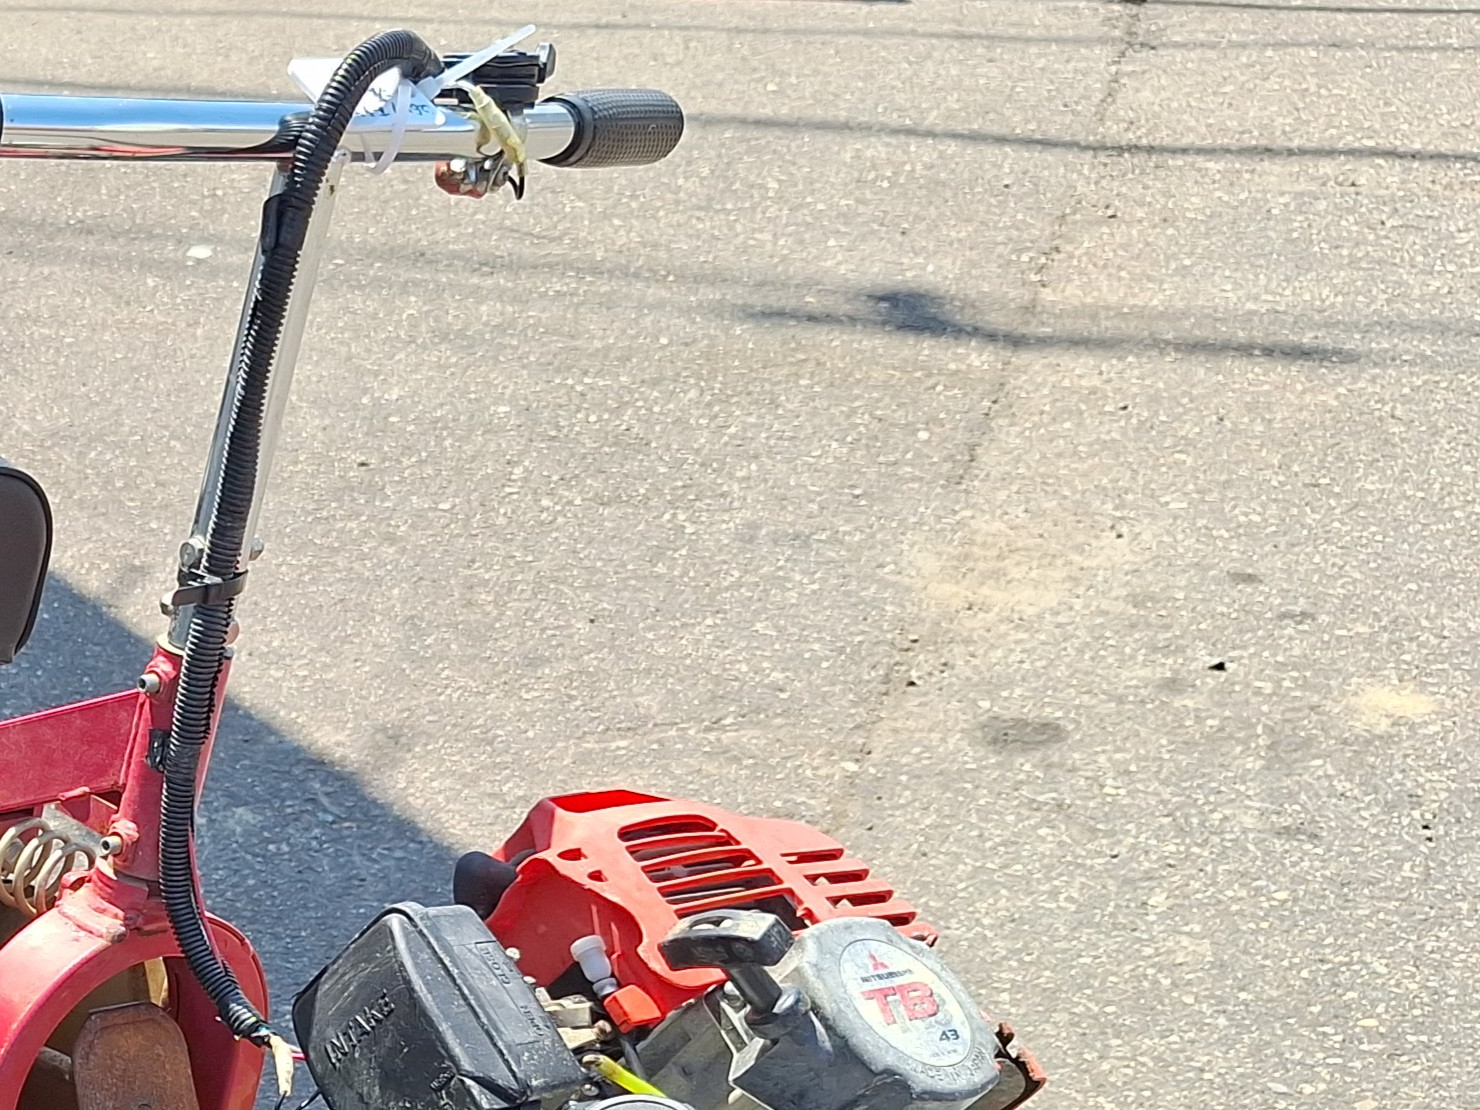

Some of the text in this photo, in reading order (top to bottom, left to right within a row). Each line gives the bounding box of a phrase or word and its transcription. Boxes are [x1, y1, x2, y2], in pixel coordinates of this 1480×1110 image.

[481, 946, 511, 986] CLOSE
[860, 969, 913, 983] MITSUBISHI
[861, 982, 939, 1025] TB
[324, 988, 395, 1070] INTAKE
[939, 1029, 961, 1042] 43
